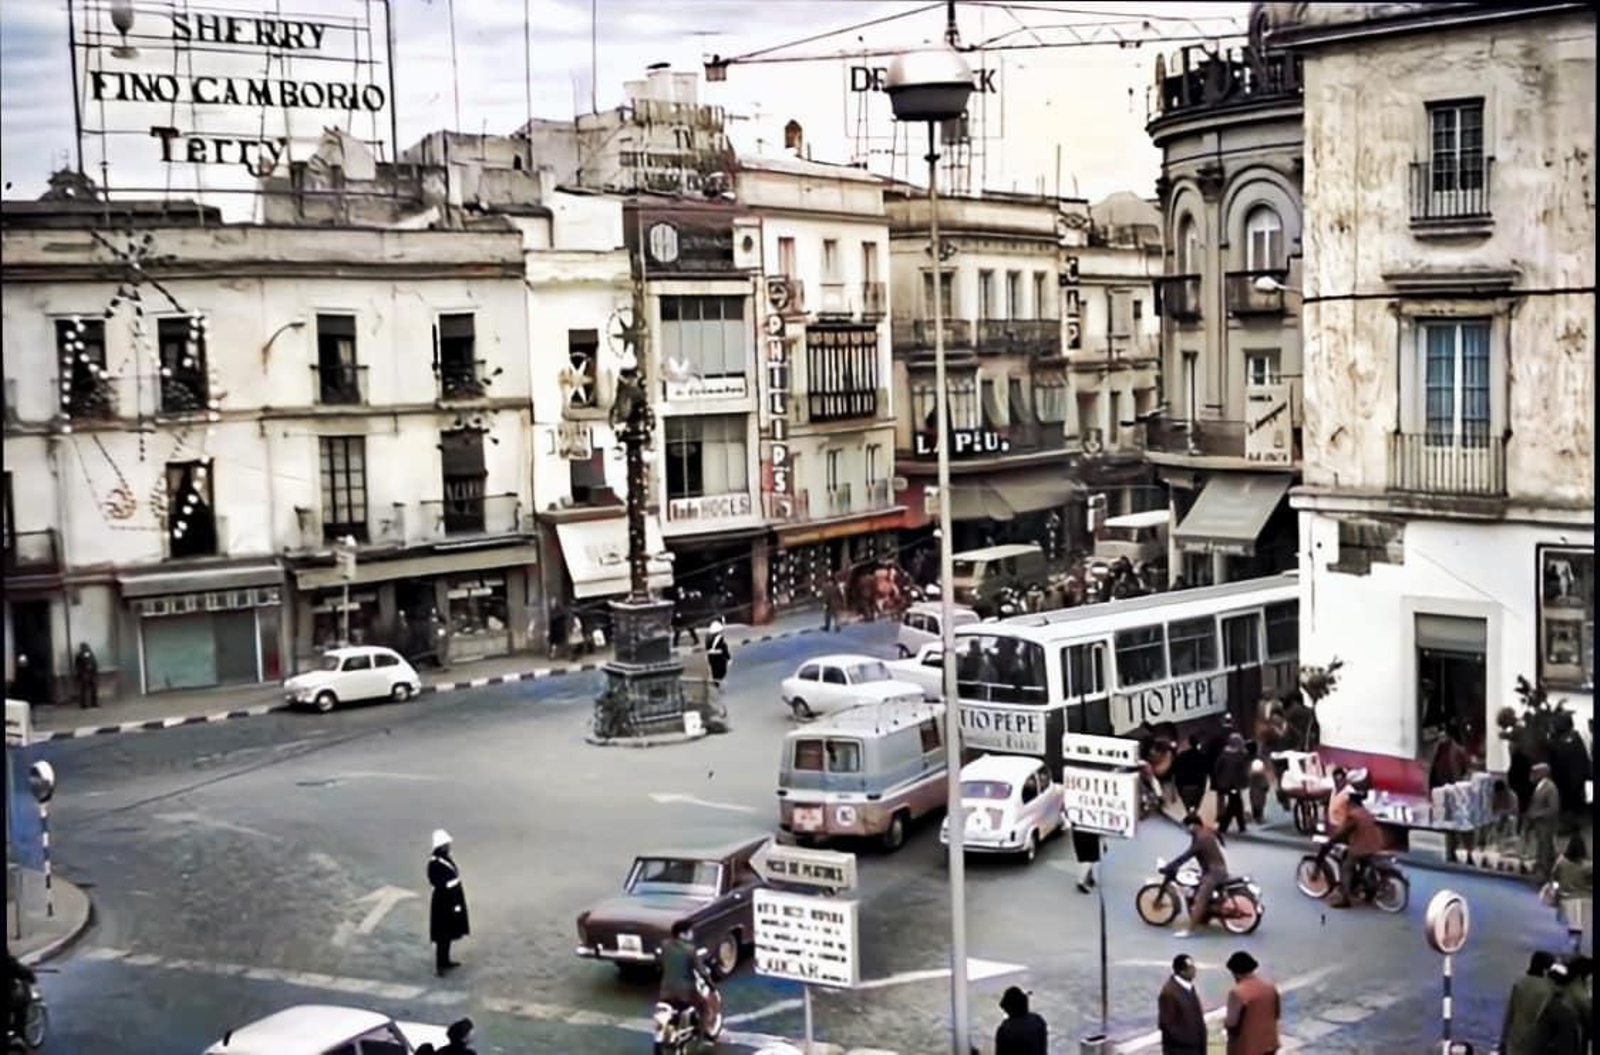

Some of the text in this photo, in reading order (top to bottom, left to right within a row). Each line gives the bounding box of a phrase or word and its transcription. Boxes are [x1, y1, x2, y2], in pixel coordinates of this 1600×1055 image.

[171, 12, 327, 49] SHERRY
[90, 71, 386, 111] FINO CAMBORIO
[151, 127, 287, 178] Terry
[767, 314, 789, 491] PHILIPS
[1127, 678, 1216, 723] TIO PEPE
[994, 711, 1038, 734] PEPE
